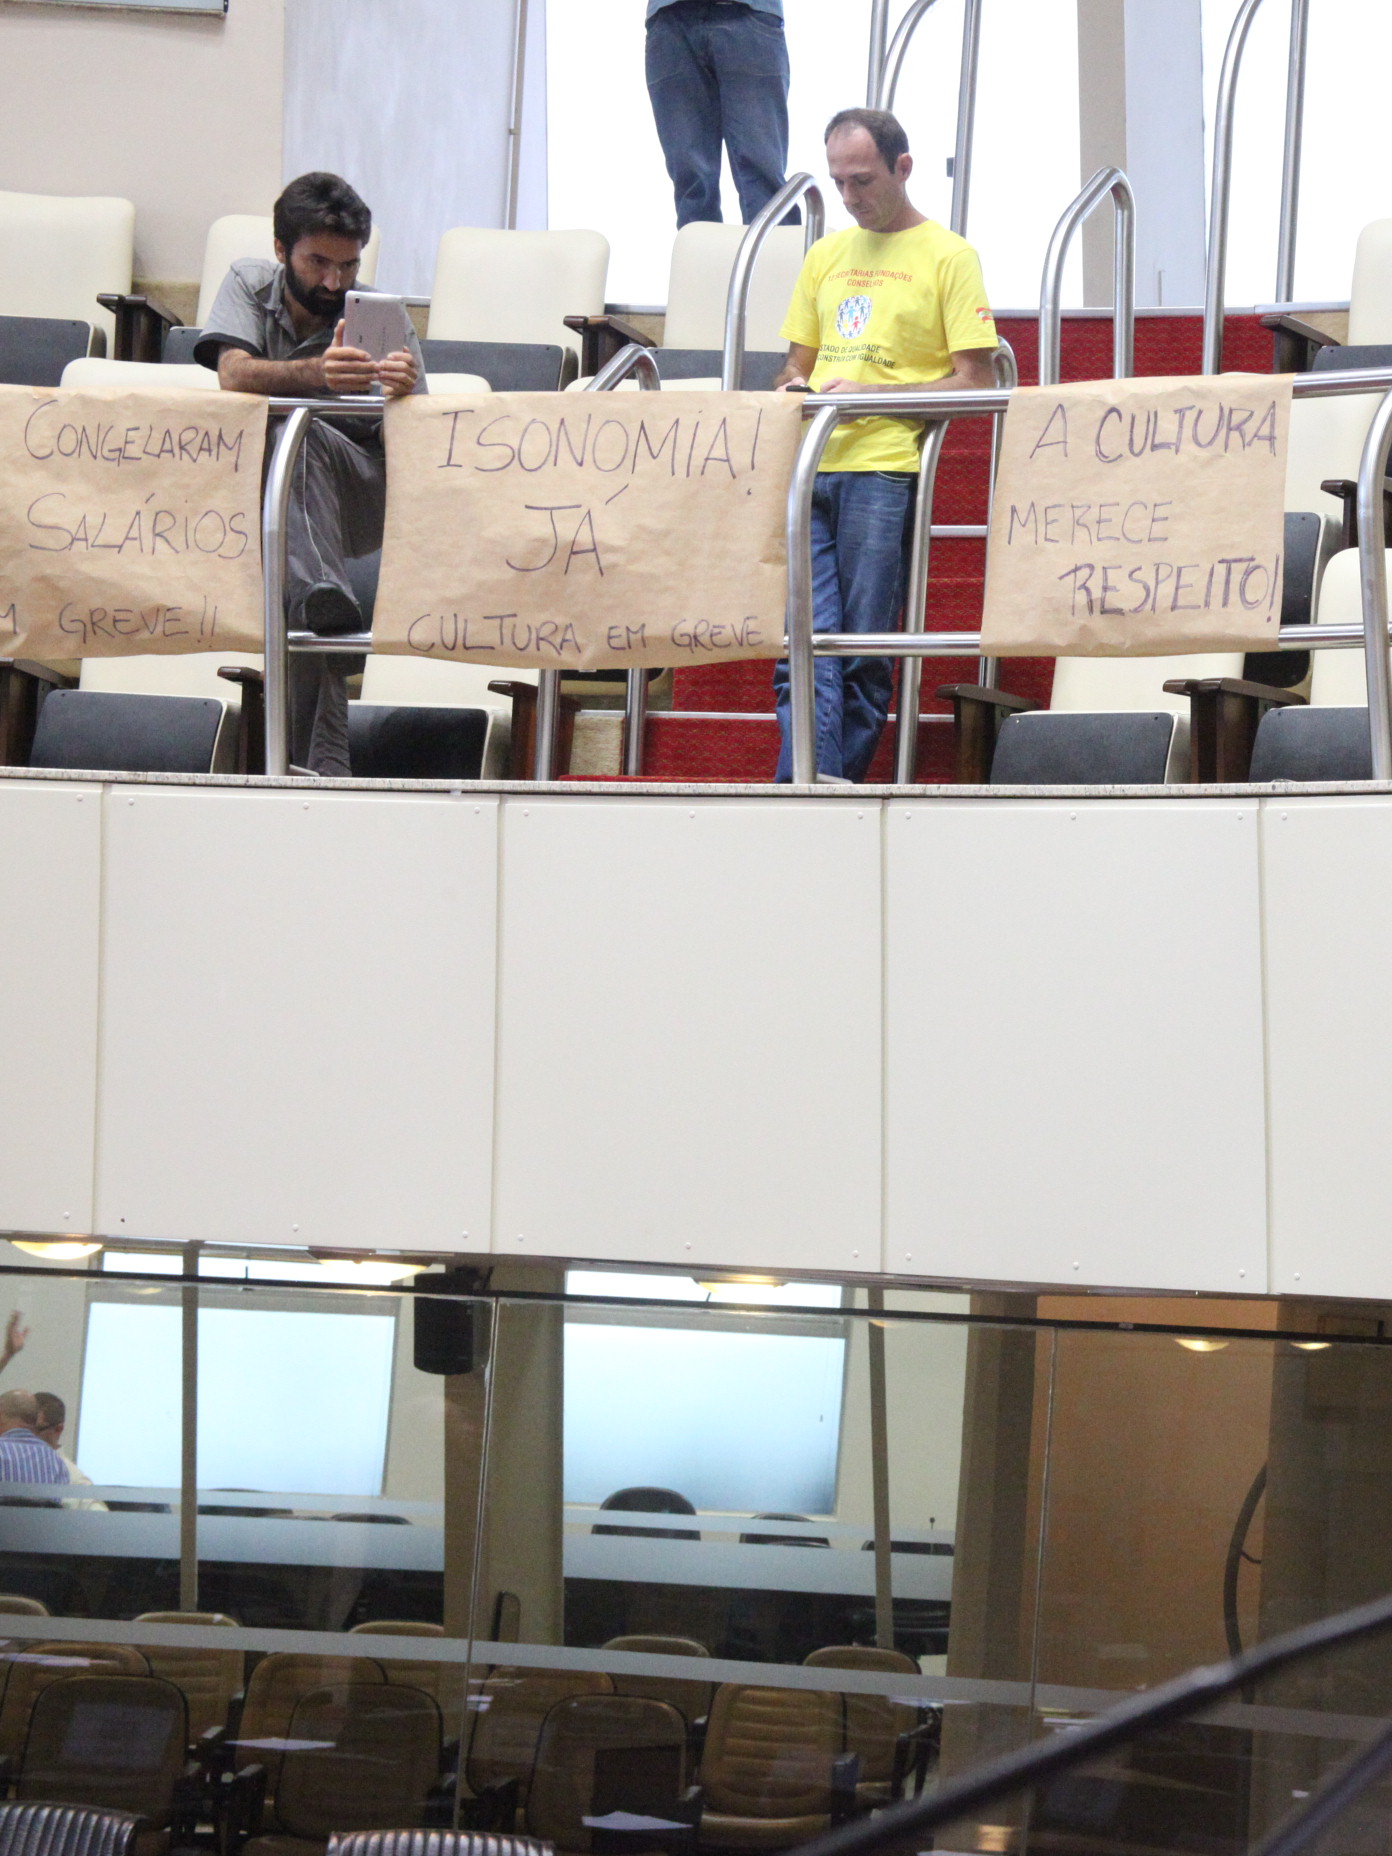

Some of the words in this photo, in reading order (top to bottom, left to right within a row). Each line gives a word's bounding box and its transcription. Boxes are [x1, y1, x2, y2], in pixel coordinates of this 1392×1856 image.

[820, 343, 840, 354] STADO
[857, 352, 897, 369] IGUALDADE
[24, 399, 245, 473] CONGELARAM
[436, 407, 764, 497] ISONOMIA!
[1029, 402, 1068, 459] A
[1094, 400, 1277, 464] CULTURA
[26, 492, 249, 560] SALÁRIOS
[505, 483, 630, 577] JÁ
[1006, 500, 1173, 546] MERECE
[1057, 552, 1280, 624] RESPEITO!
[407, 612, 582, 656] CULTURA
[606, 622, 647, 650] EM
[670, 615, 765, 654] GREVE
